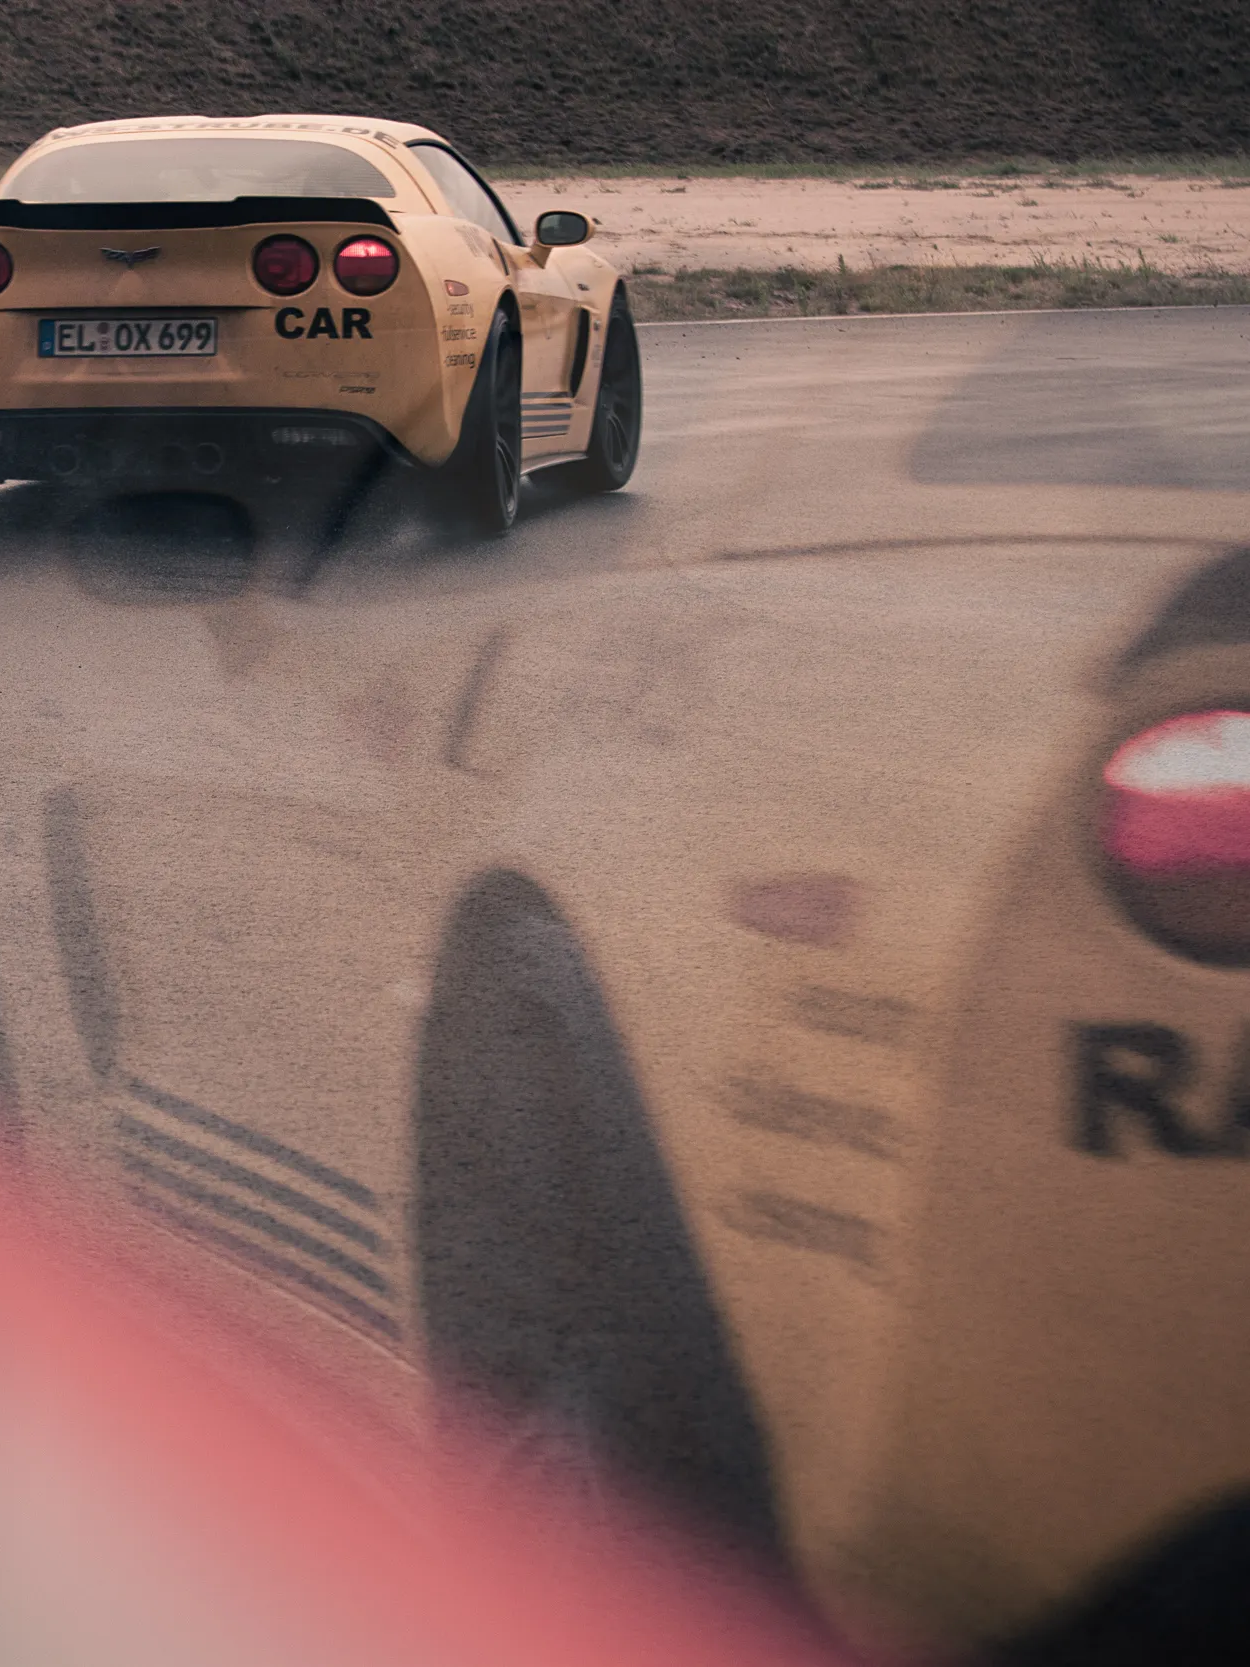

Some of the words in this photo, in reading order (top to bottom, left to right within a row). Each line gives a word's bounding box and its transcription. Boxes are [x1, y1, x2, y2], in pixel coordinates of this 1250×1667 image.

[58, 324, 95, 352] EL
[115, 323, 152, 352] OX
[159, 322, 212, 351] 699
[275, 307, 373, 339] CAR
